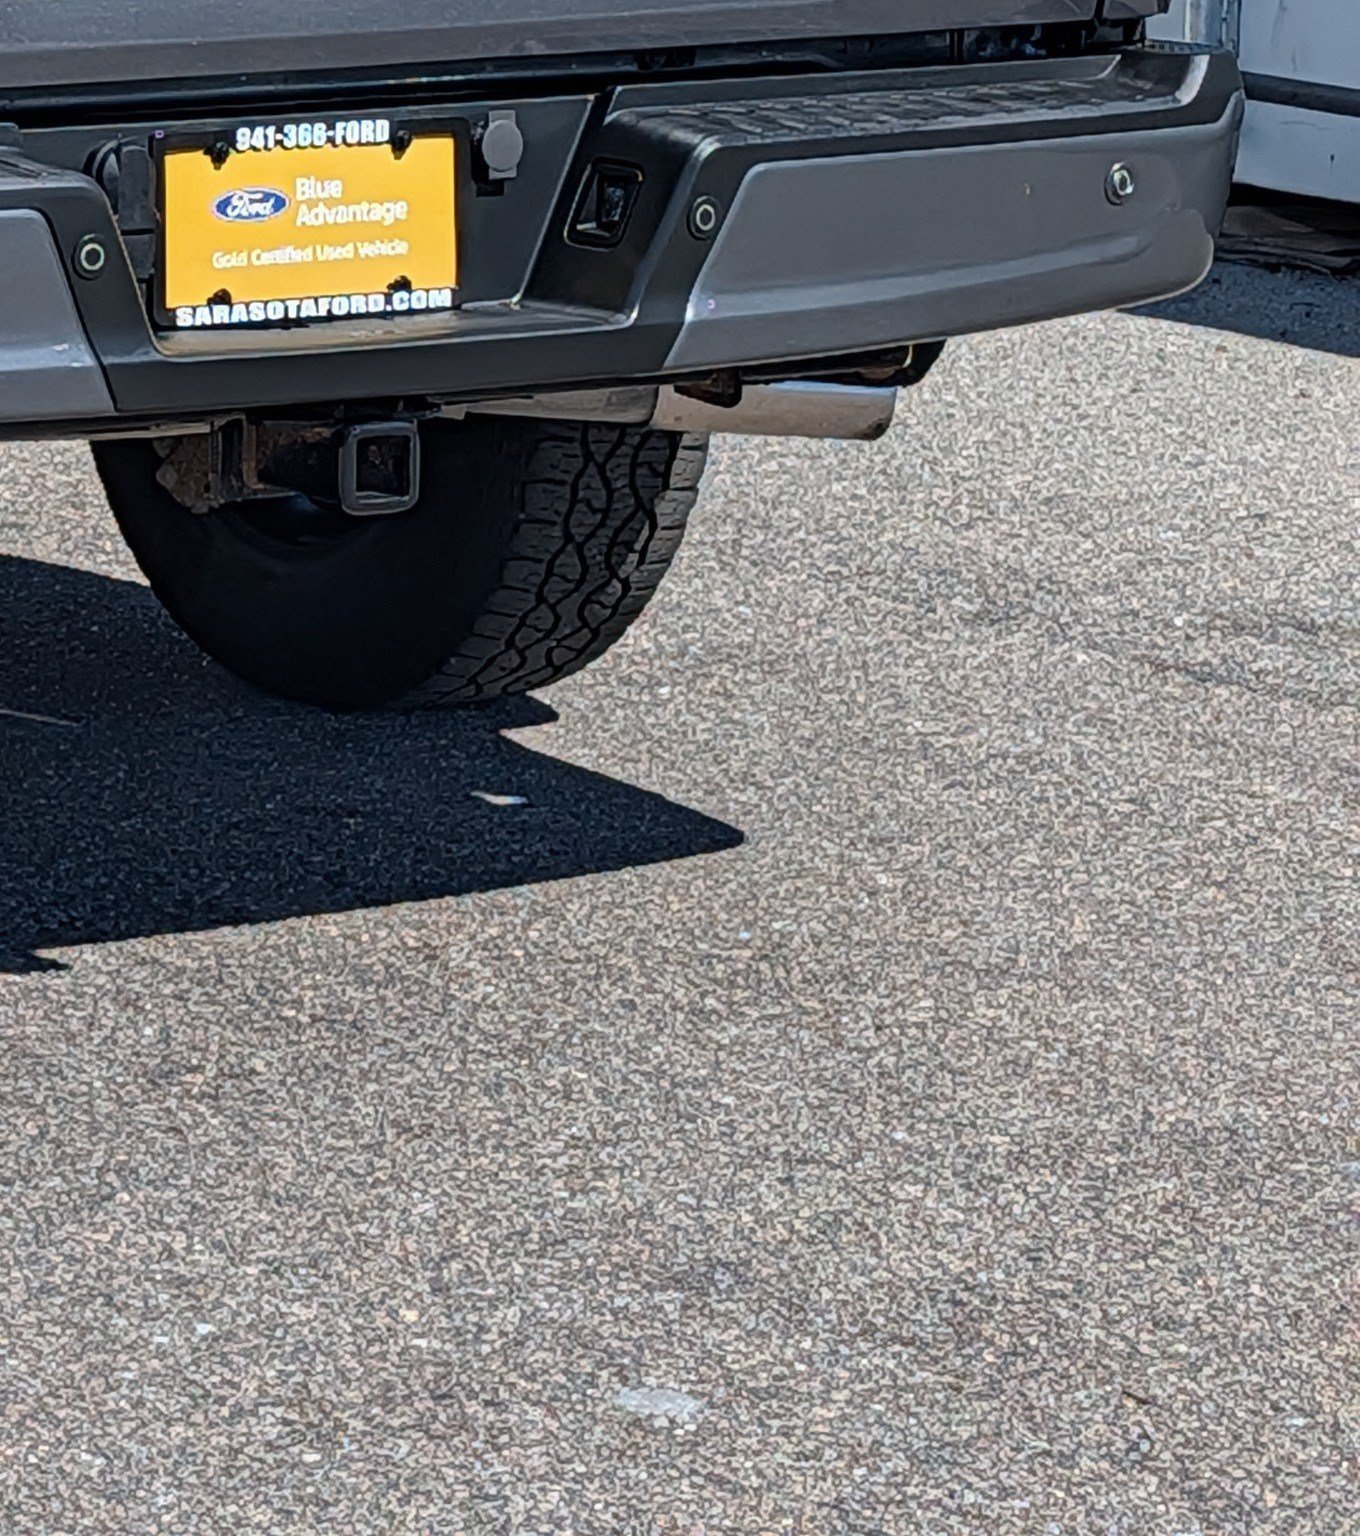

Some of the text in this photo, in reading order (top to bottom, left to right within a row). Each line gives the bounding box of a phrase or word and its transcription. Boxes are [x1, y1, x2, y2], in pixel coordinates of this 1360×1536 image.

[235, 119, 391, 151] 941-366-FORD
[295, 176, 344, 201] Blue
[225, 190, 276, 219] Ford
[295, 198, 409, 228] Advantage
[211, 250, 248, 270] Gold
[315, 242, 355, 262] Used
[175, 288, 453, 328] SARASOTAFORD.COM
